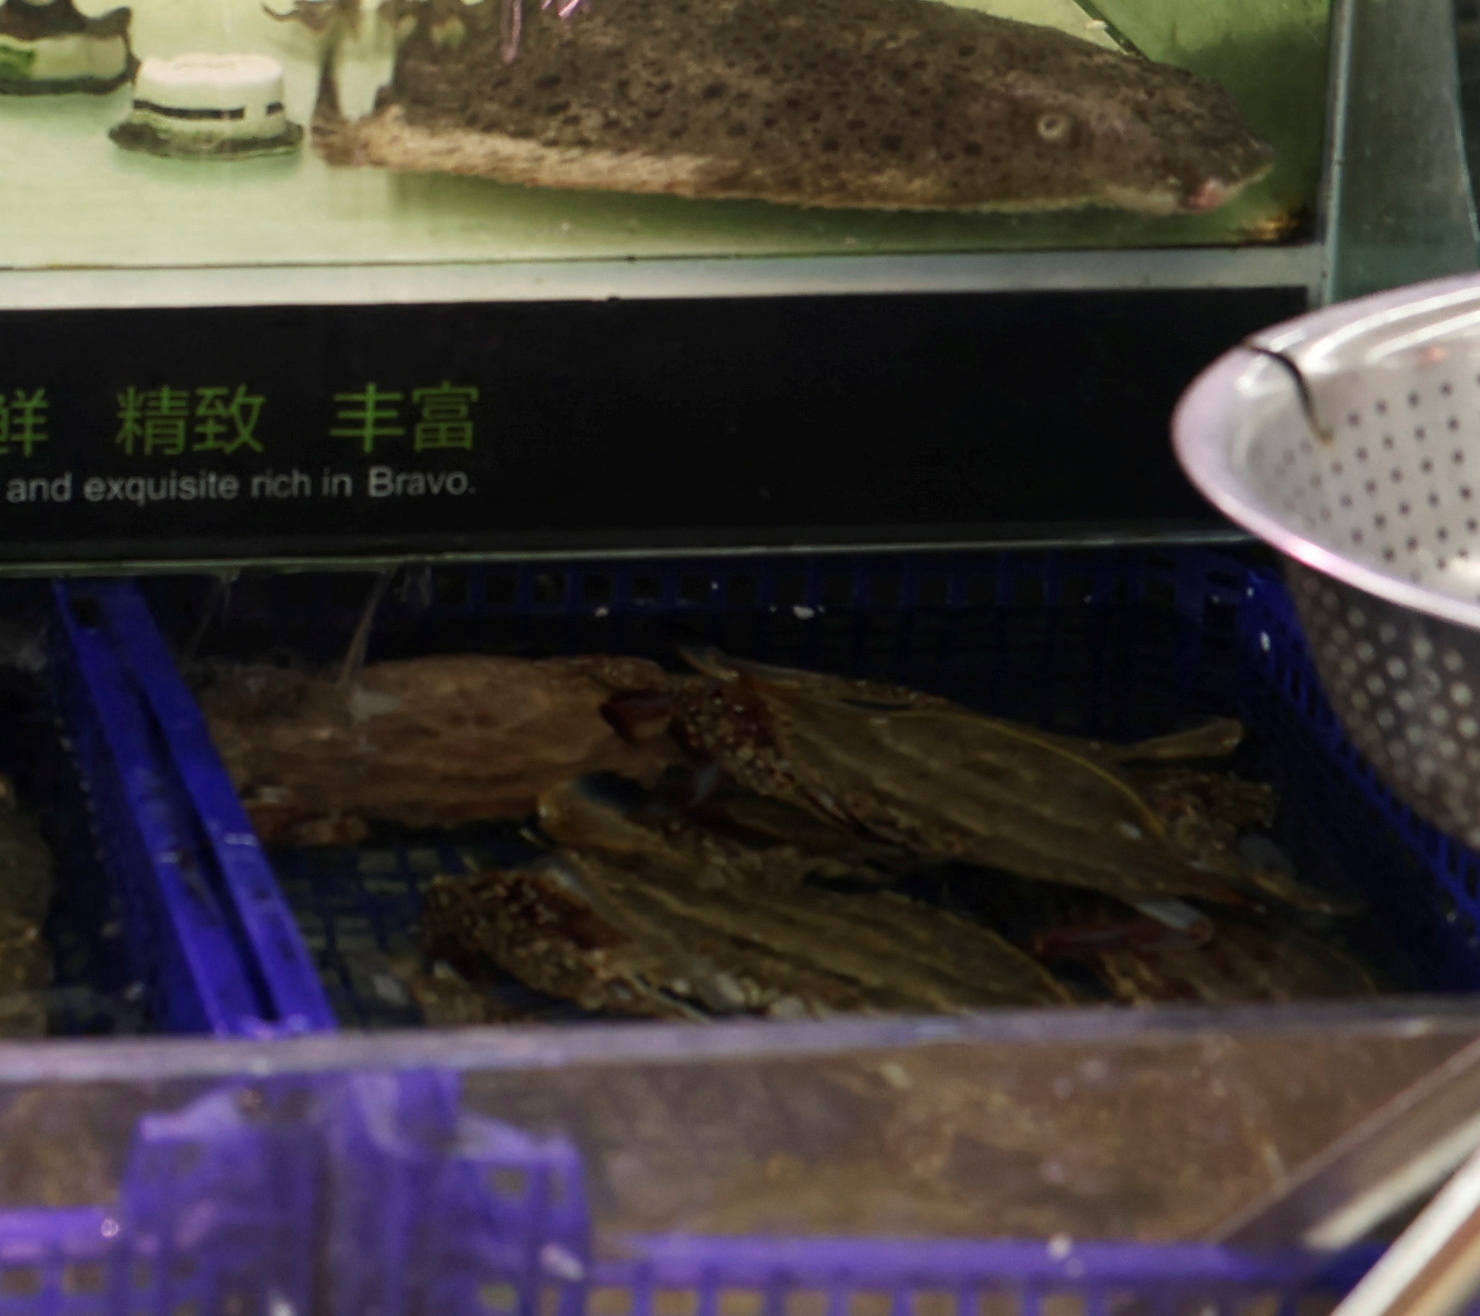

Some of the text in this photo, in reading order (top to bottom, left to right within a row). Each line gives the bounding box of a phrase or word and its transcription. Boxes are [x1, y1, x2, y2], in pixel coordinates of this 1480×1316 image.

[113, 383, 267, 458] 精致
[328, 380, 479, 453] 丰富
[5, 473, 73, 504] and
[82, 471, 240, 509] exquisite
[249, 469, 312, 500] rich
[321, 469, 353, 498] in
[367, 466, 477, 499] Bravo.
